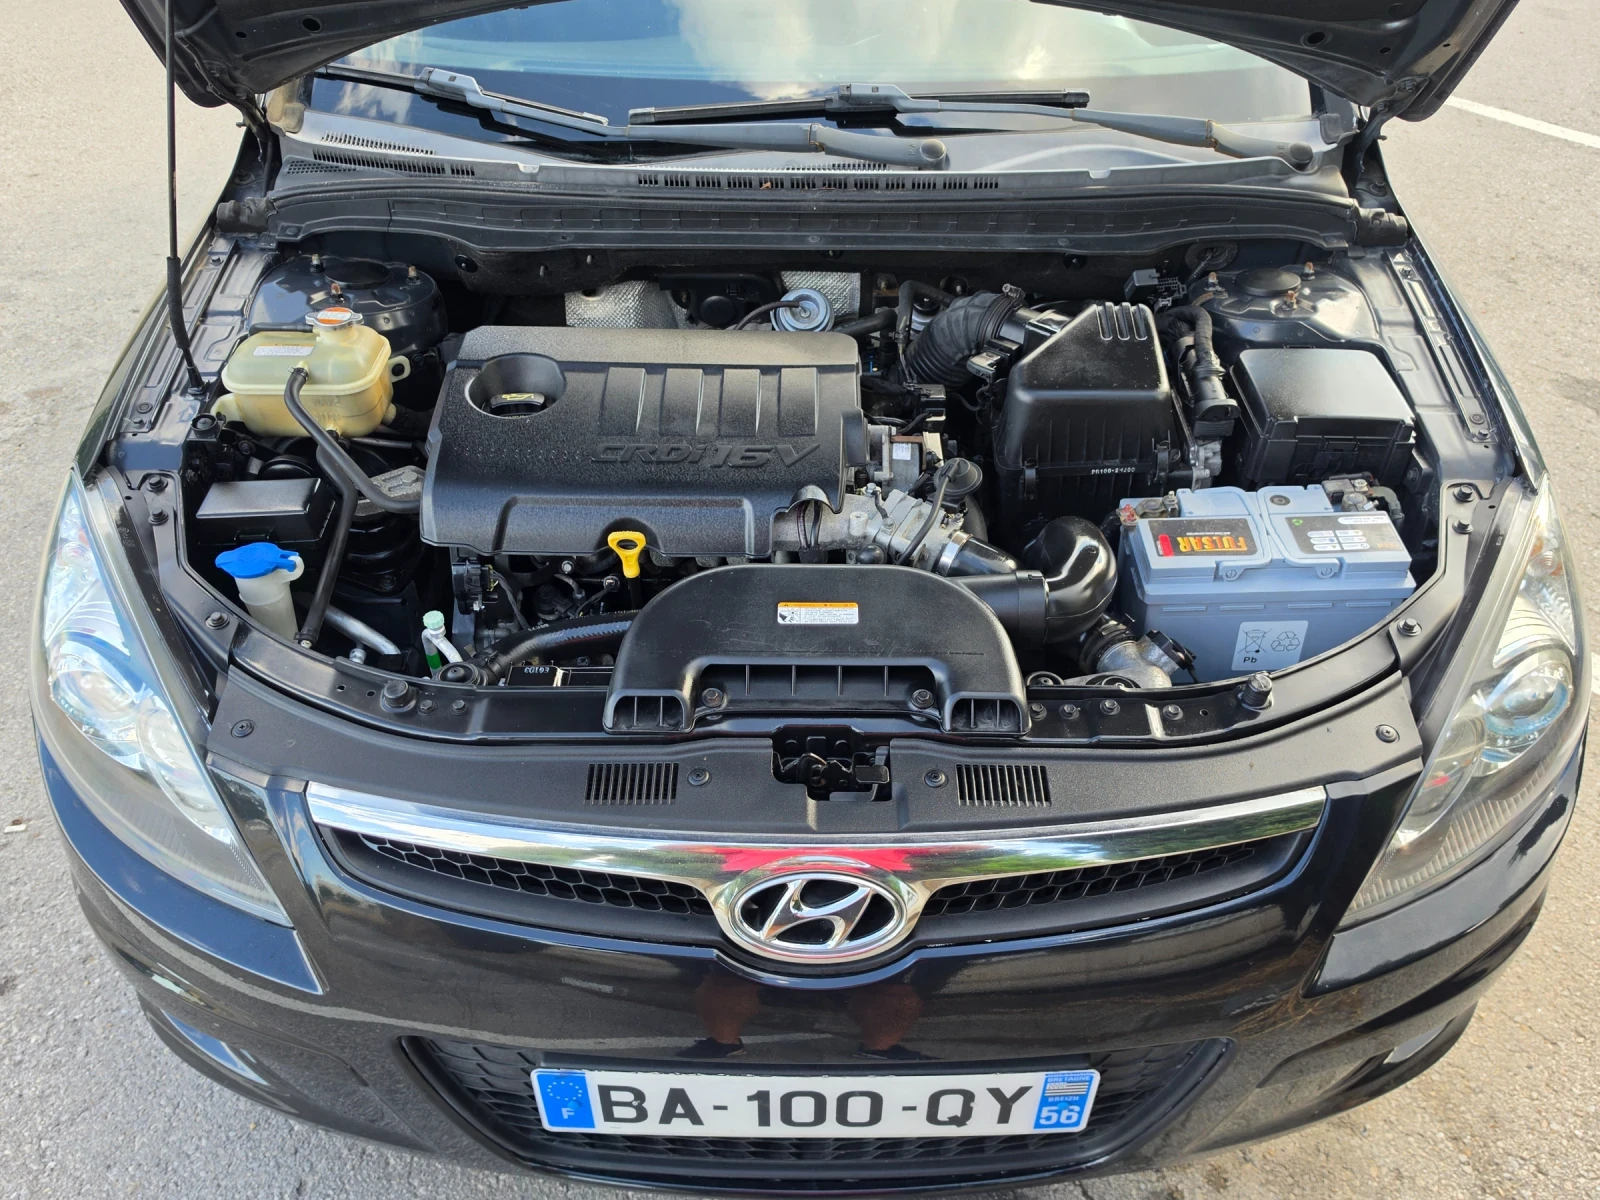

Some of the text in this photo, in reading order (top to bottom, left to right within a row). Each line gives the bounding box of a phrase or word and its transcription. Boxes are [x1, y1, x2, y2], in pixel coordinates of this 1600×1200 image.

[1243, 656, 1257, 664] Pb
[561, 1107, 575, 1119] F
[1039, 1105, 1081, 1125] 56
